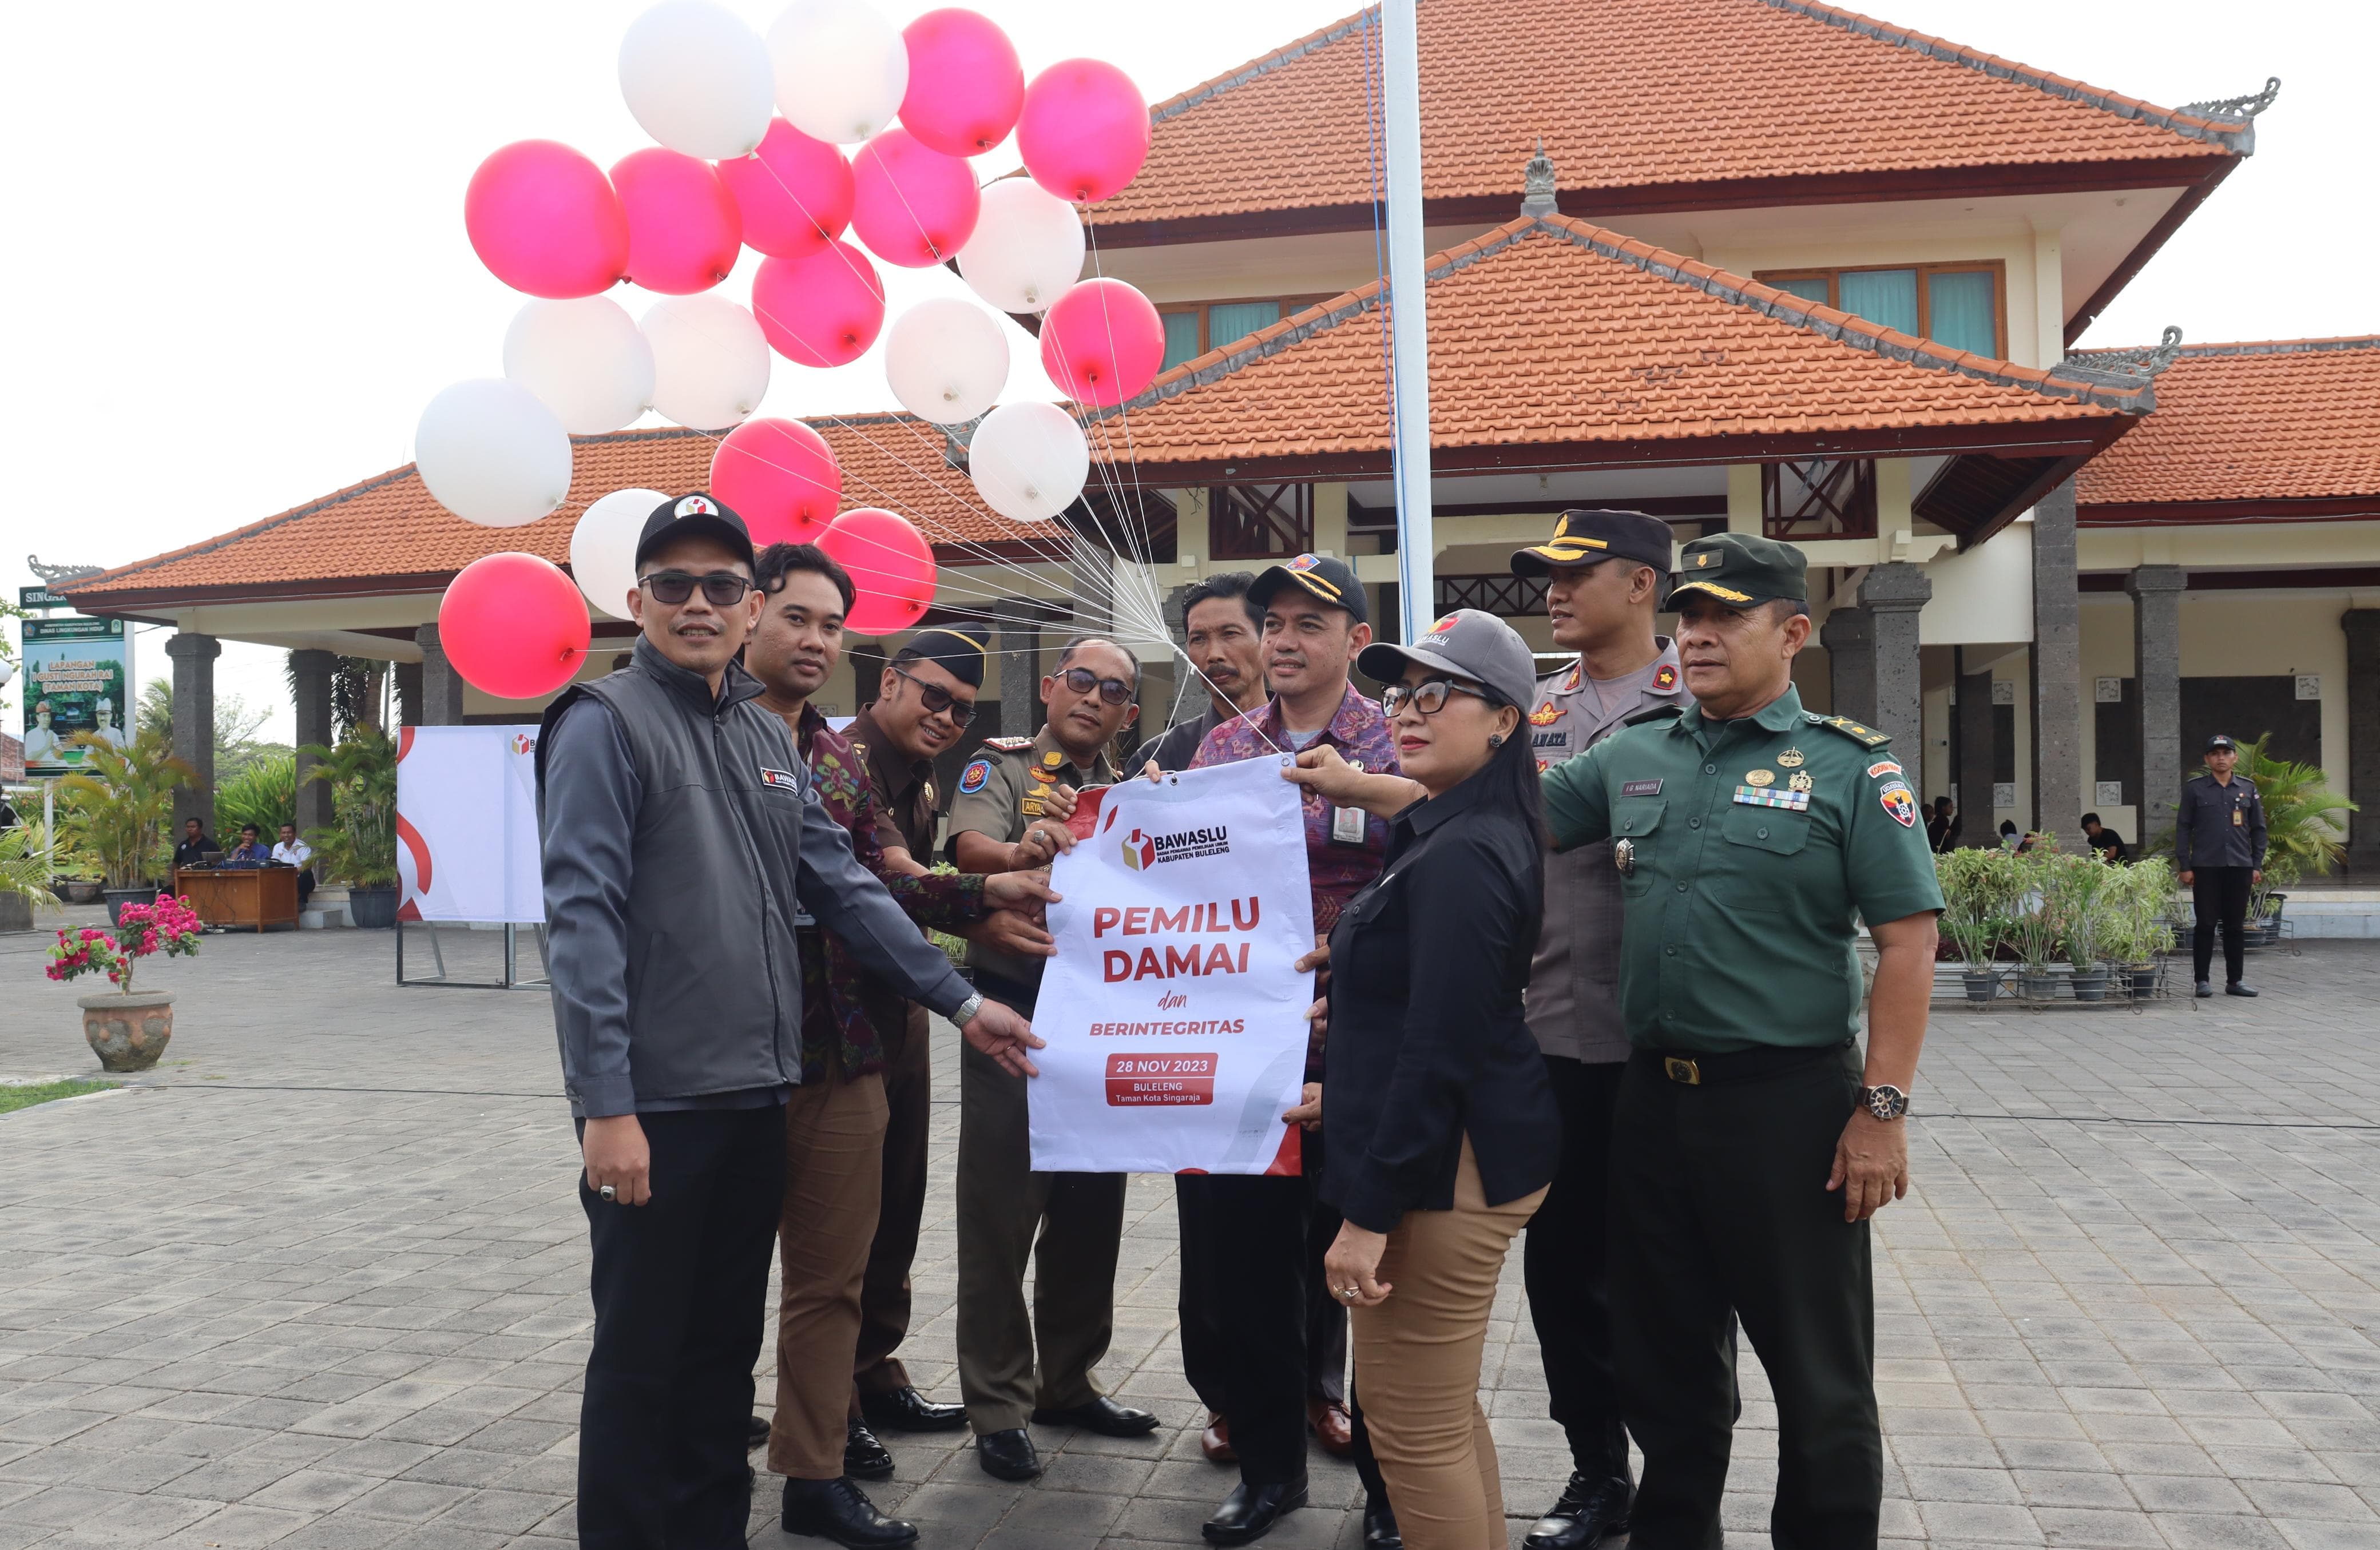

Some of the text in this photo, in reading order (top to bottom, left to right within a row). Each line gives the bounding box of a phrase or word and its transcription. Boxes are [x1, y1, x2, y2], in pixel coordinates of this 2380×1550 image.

[49, 660, 94, 670] LAPANGAN
[32, 669, 113, 682] I GUSTI NGURAH RAI
[42, 680, 104, 694] (TAMAN KOTA)
[1635, 783, 1657, 791] NARIADA
[1883, 782, 1903, 792] UDAYANA
[1154, 826, 1227, 850] BAWASLU
[1157, 846, 1229, 864] KABUPATEN BULELENG
[1094, 896, 1260, 938] PEMILU
[1104, 943, 1250, 983] DAMAI
[1157, 990, 1187, 1011] dan
[1089, 1019, 1244, 1036] BERINTEGRITAS
[1116, 1060, 1208, 1072] 28 NOV 2023
[1134, 1082, 1183, 1092] BULELENG
[1116, 1094, 1141, 1102] Taman
[1163, 1094, 1200, 1103] Singaraja
